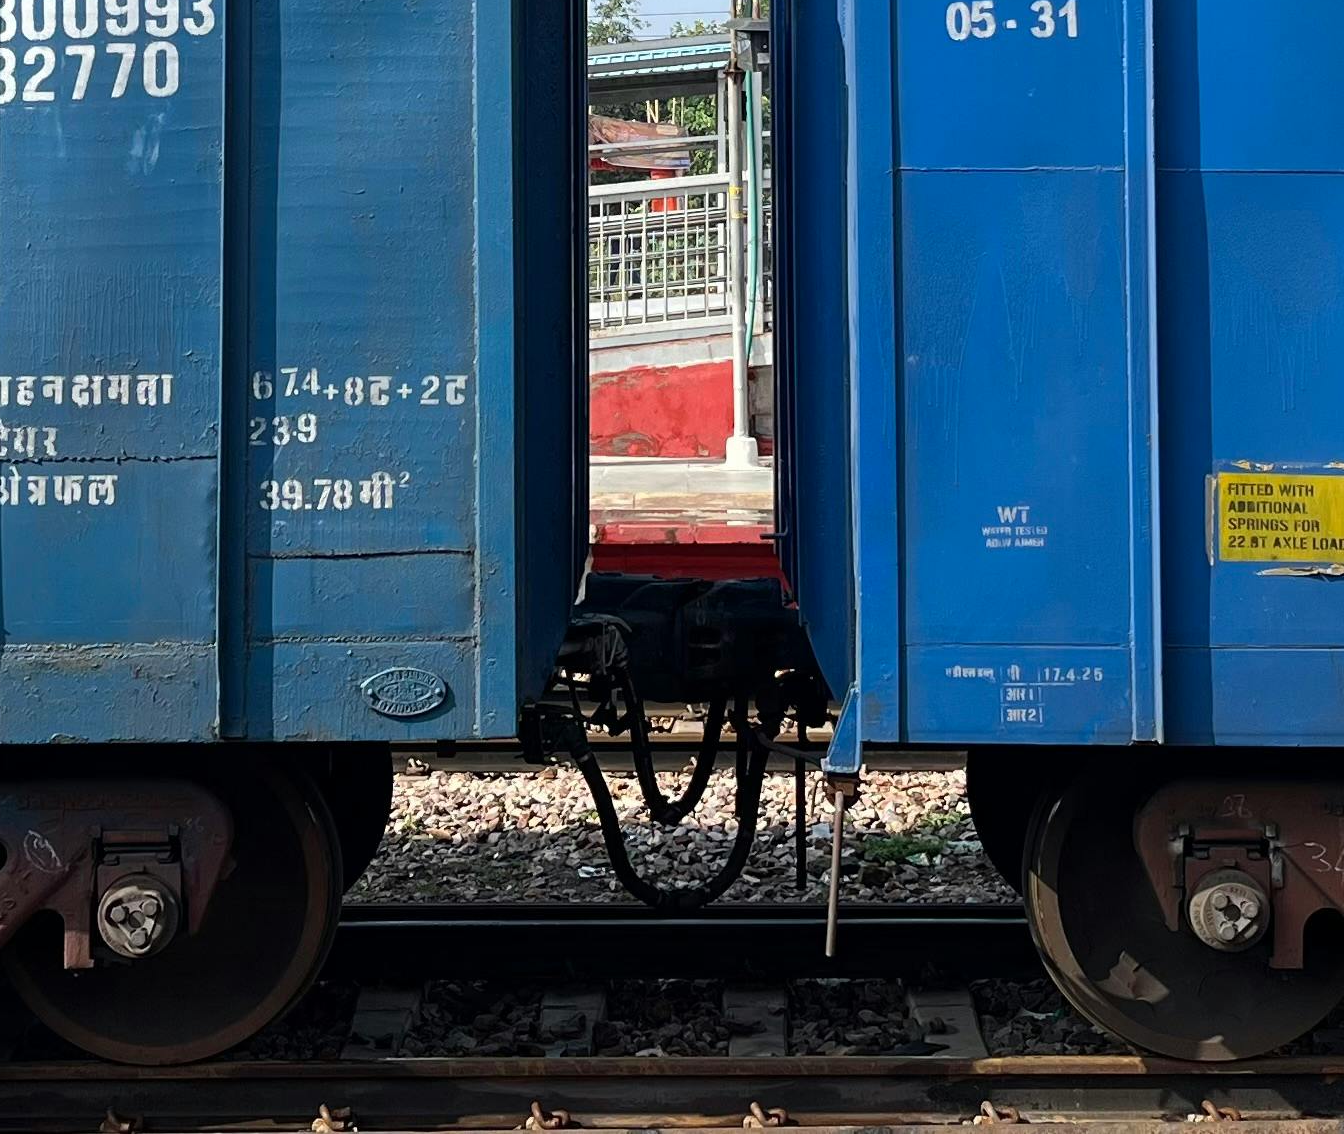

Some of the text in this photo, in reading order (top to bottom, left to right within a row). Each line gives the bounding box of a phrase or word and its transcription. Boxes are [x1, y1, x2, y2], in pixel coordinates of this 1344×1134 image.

[1227, 483, 1315, 497] FITTED WITH
[1227, 500, 1308, 514] ADDITIONAL
[997, 505, 1030, 524] WT
[1227, 517, 1320, 532] SPRINGS FOR
[1272, 536, 1308, 550] AXLE
